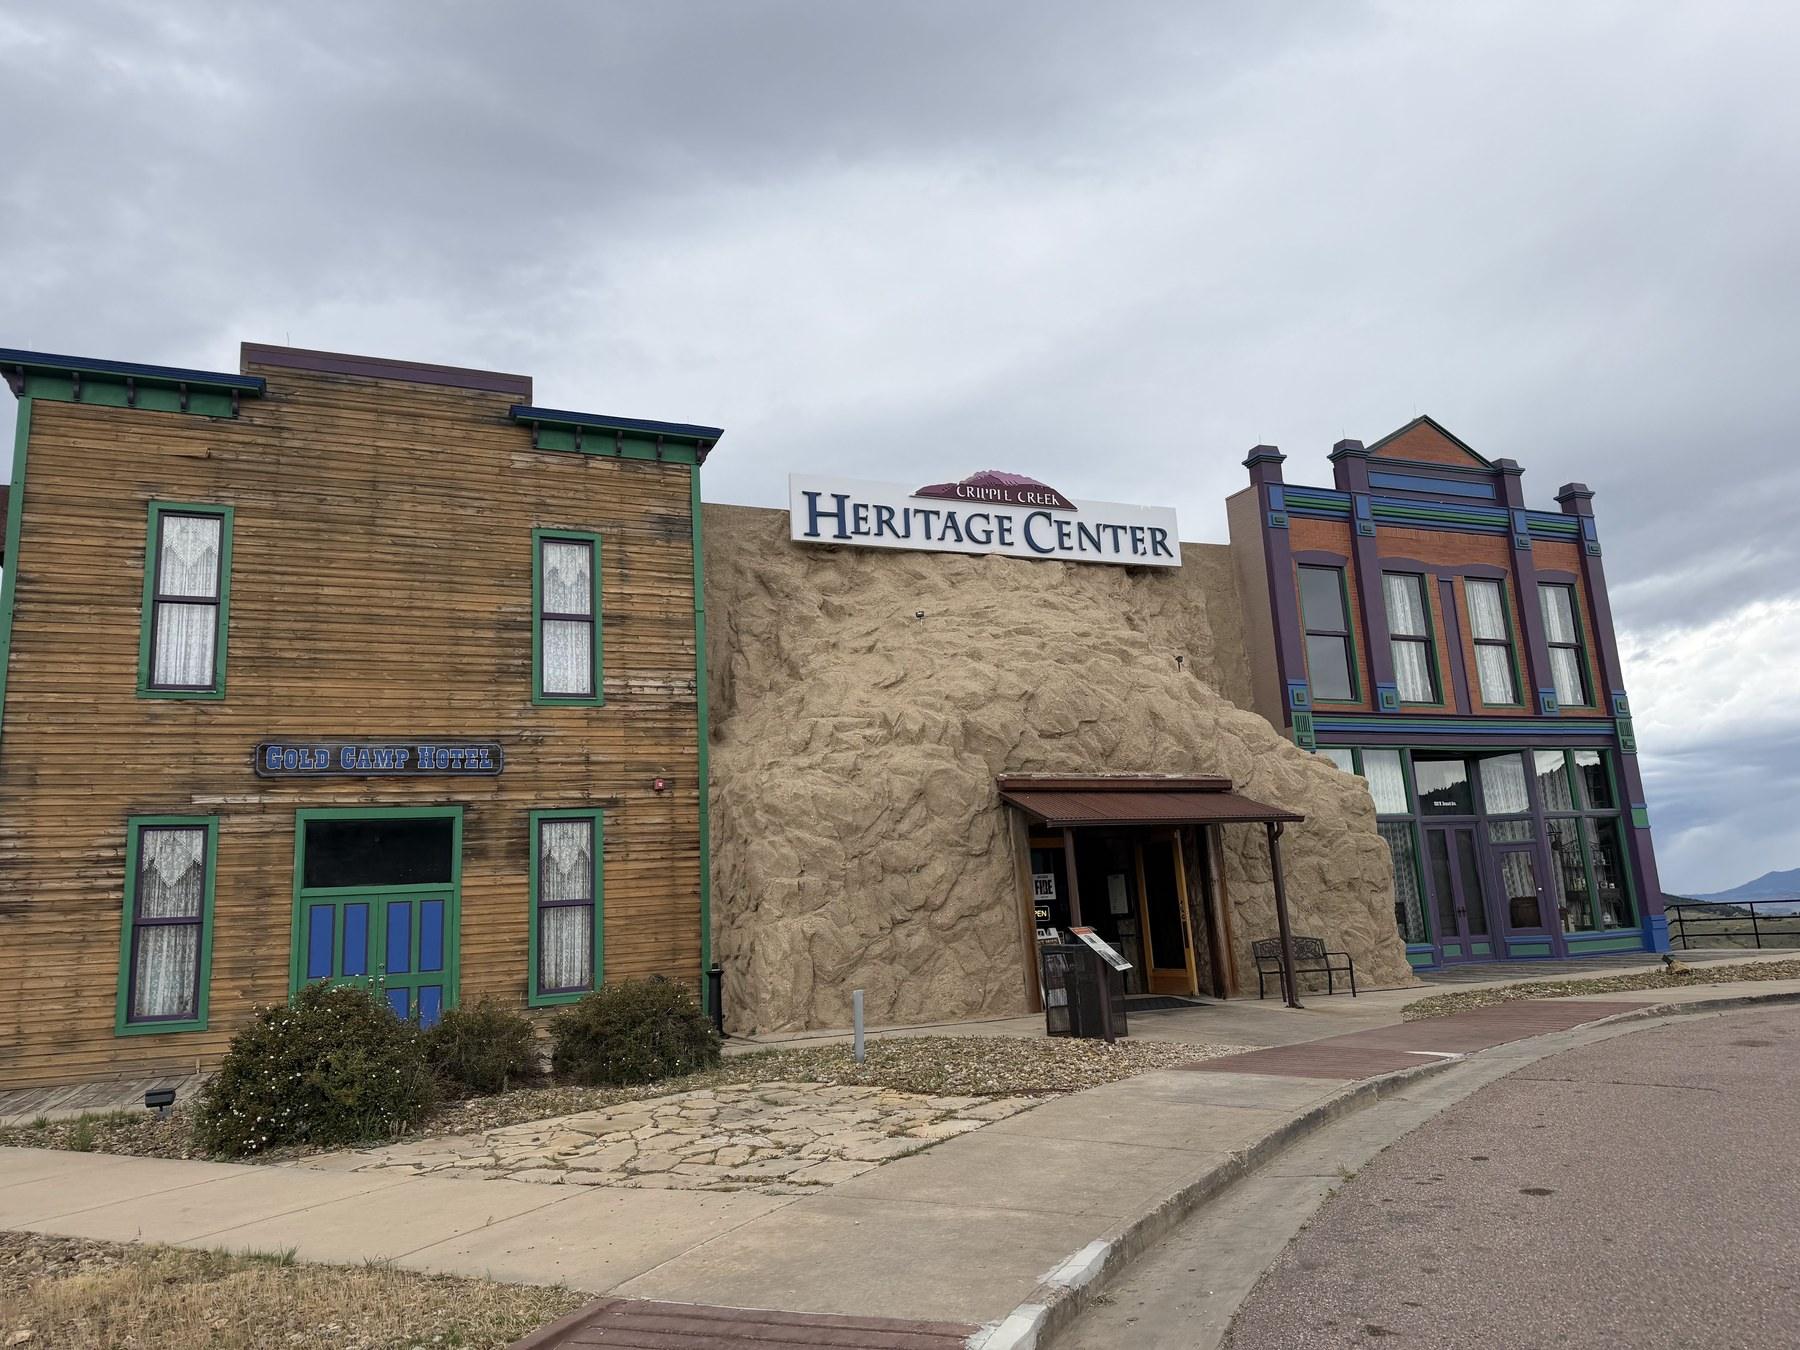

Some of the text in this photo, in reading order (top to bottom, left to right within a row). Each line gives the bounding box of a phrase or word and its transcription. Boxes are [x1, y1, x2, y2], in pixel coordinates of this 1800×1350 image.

[1017, 492, 1060, 506] CREEK
[802, 490, 1174, 558] HERITAGE CENTER
[266, 746, 493, 769] GOLD CAMP HOTEL
[1034, 909, 1047, 917] PEN
